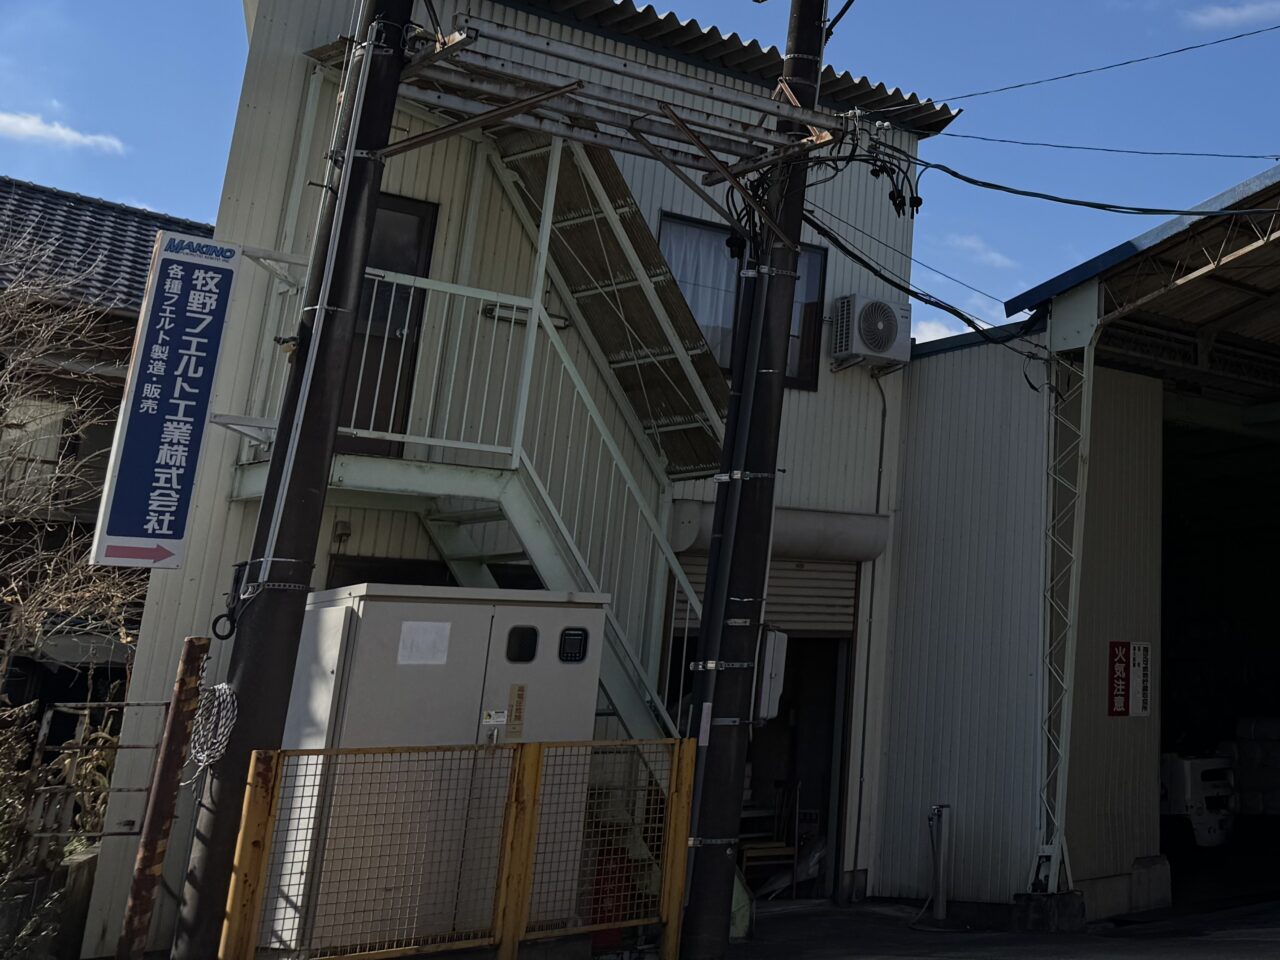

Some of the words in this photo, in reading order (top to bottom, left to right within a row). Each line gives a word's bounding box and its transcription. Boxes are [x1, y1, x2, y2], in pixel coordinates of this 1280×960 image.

[164, 237, 236, 259] MAKINO
[139, 263, 186, 415] 各種フエルト製造・販売
[143, 268, 223, 535] 牧野フエルト工業株式会社
[1113, 645, 1126, 712] 火気注意
